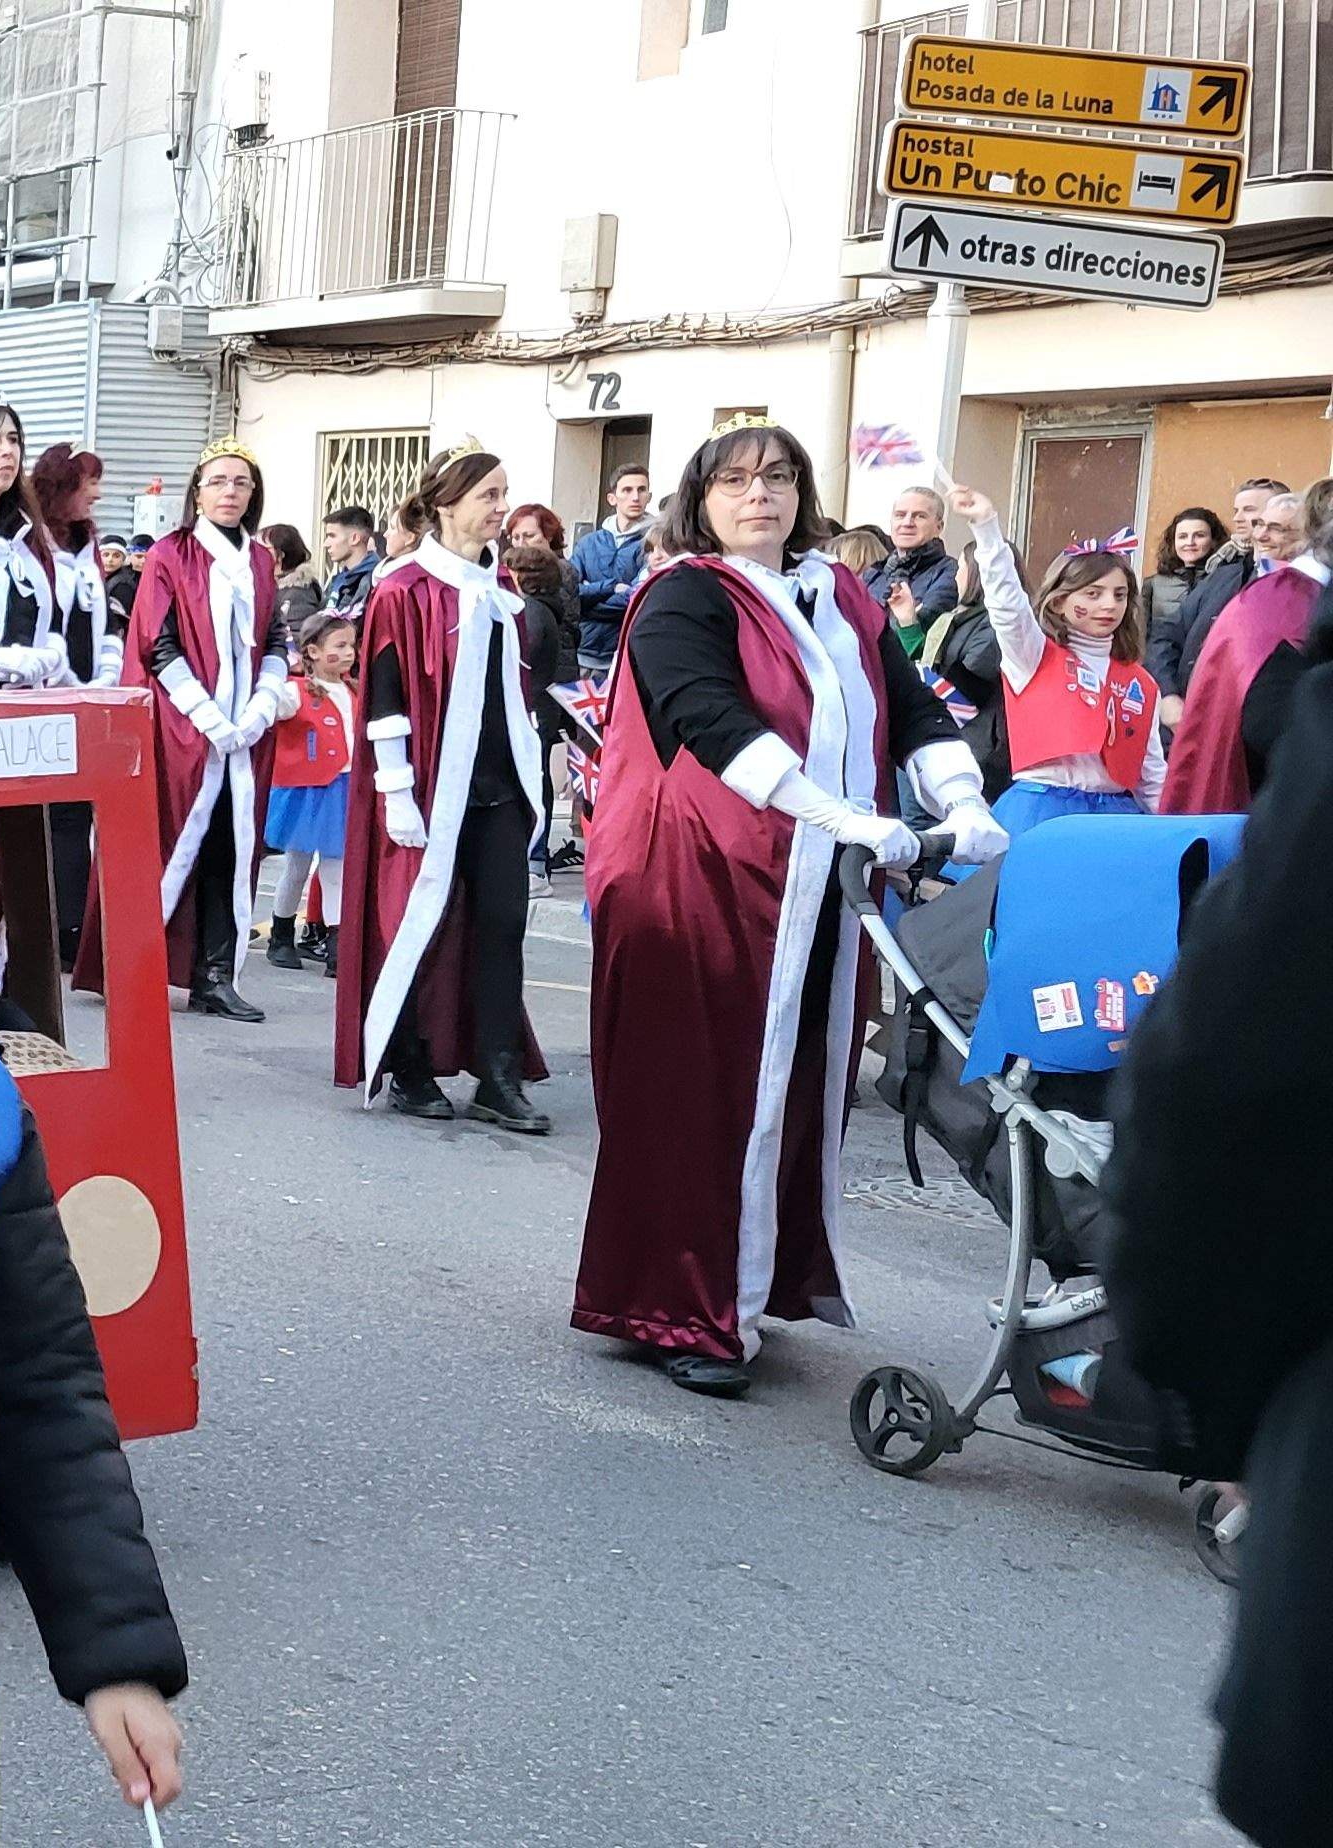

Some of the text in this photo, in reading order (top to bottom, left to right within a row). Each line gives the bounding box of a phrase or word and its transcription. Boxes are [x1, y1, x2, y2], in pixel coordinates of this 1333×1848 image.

[919, 51, 974, 75] hotel
[916, 79, 1113, 114] Posada de la Luna
[904, 132, 974, 158] hostal
[899, 157, 1122, 206] Un Puto Chic
[959, 234, 1207, 288] otras direcciones
[587, 371, 622, 412] 72
